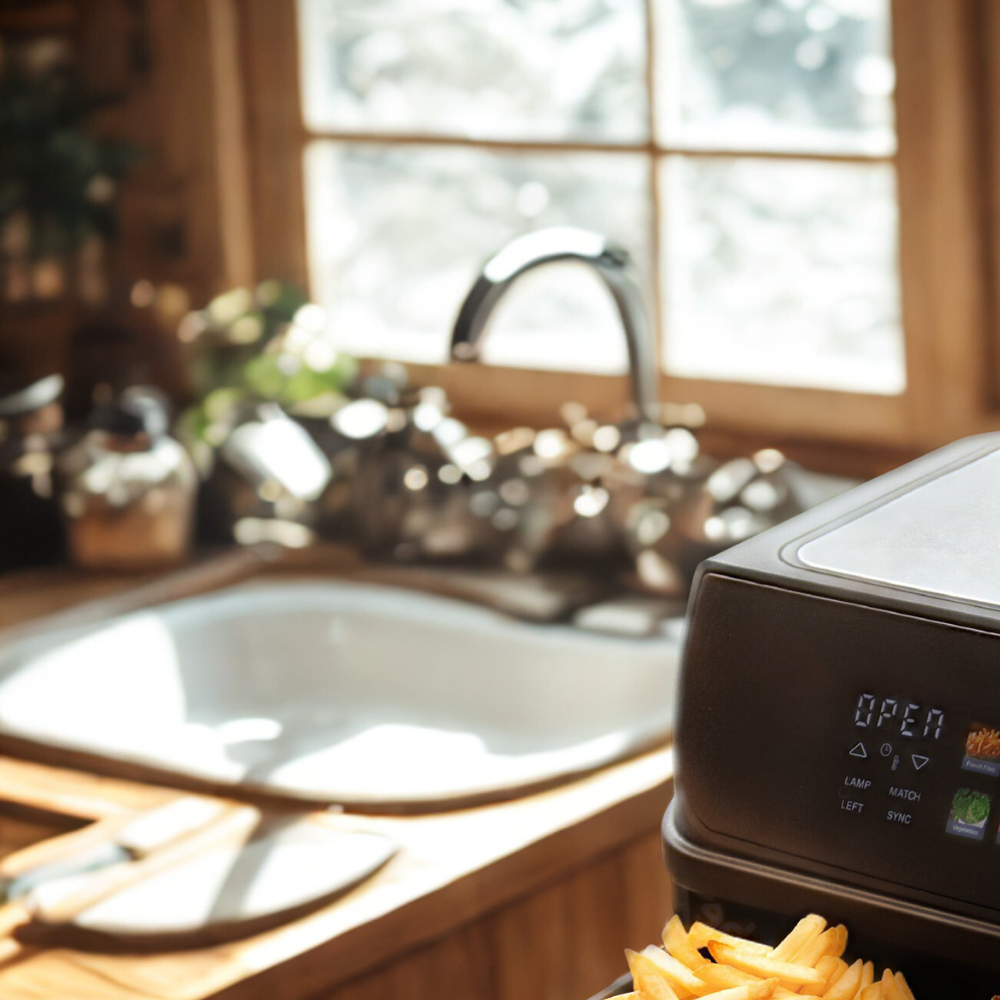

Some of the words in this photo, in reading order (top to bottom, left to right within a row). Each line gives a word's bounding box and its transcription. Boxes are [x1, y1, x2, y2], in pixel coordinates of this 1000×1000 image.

[844, 775, 872, 790] LAMP
[888, 786, 922, 802] MATCH
[840, 799, 865, 813] LEFT
[886, 810, 912, 825] SYNC
